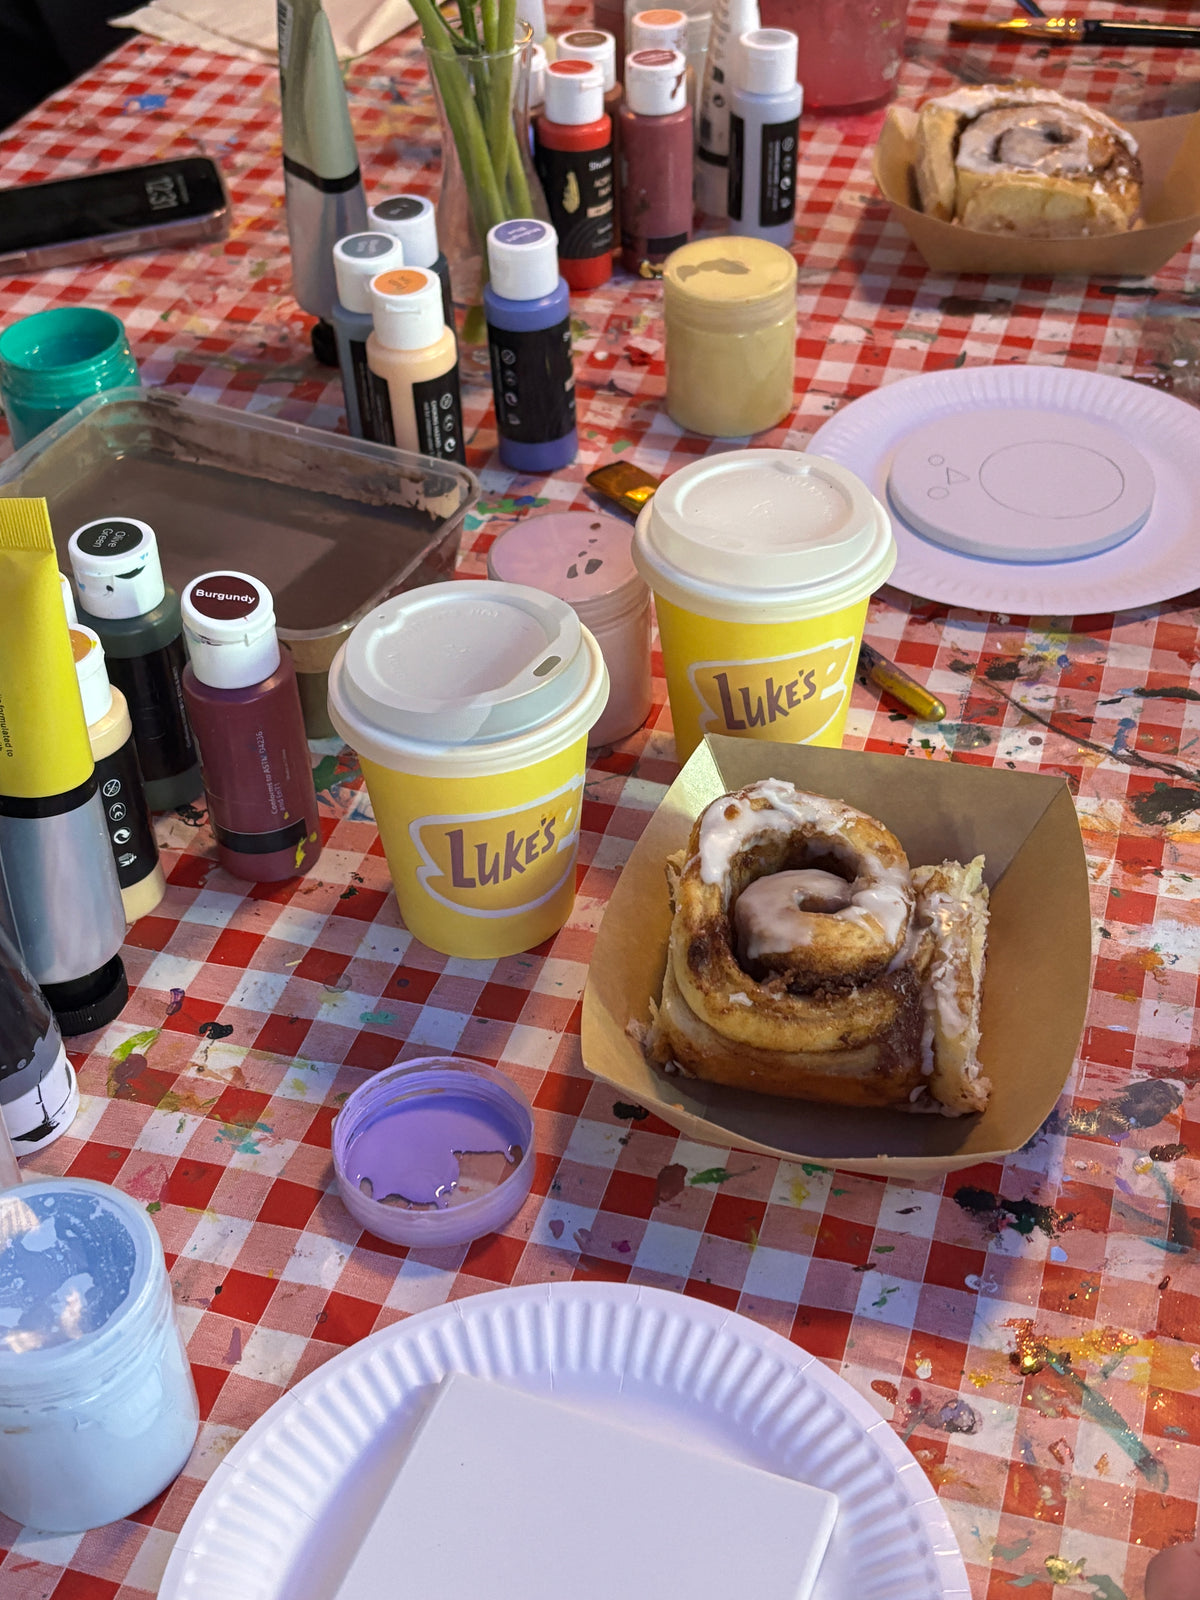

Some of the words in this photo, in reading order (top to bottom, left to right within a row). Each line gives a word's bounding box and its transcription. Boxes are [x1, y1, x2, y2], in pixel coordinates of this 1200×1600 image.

[93, 528, 114, 548] Green
[108, 530, 126, 548] Olive
[196, 588, 256, 604] Burgundy
[6, 749, 14, 758] to
